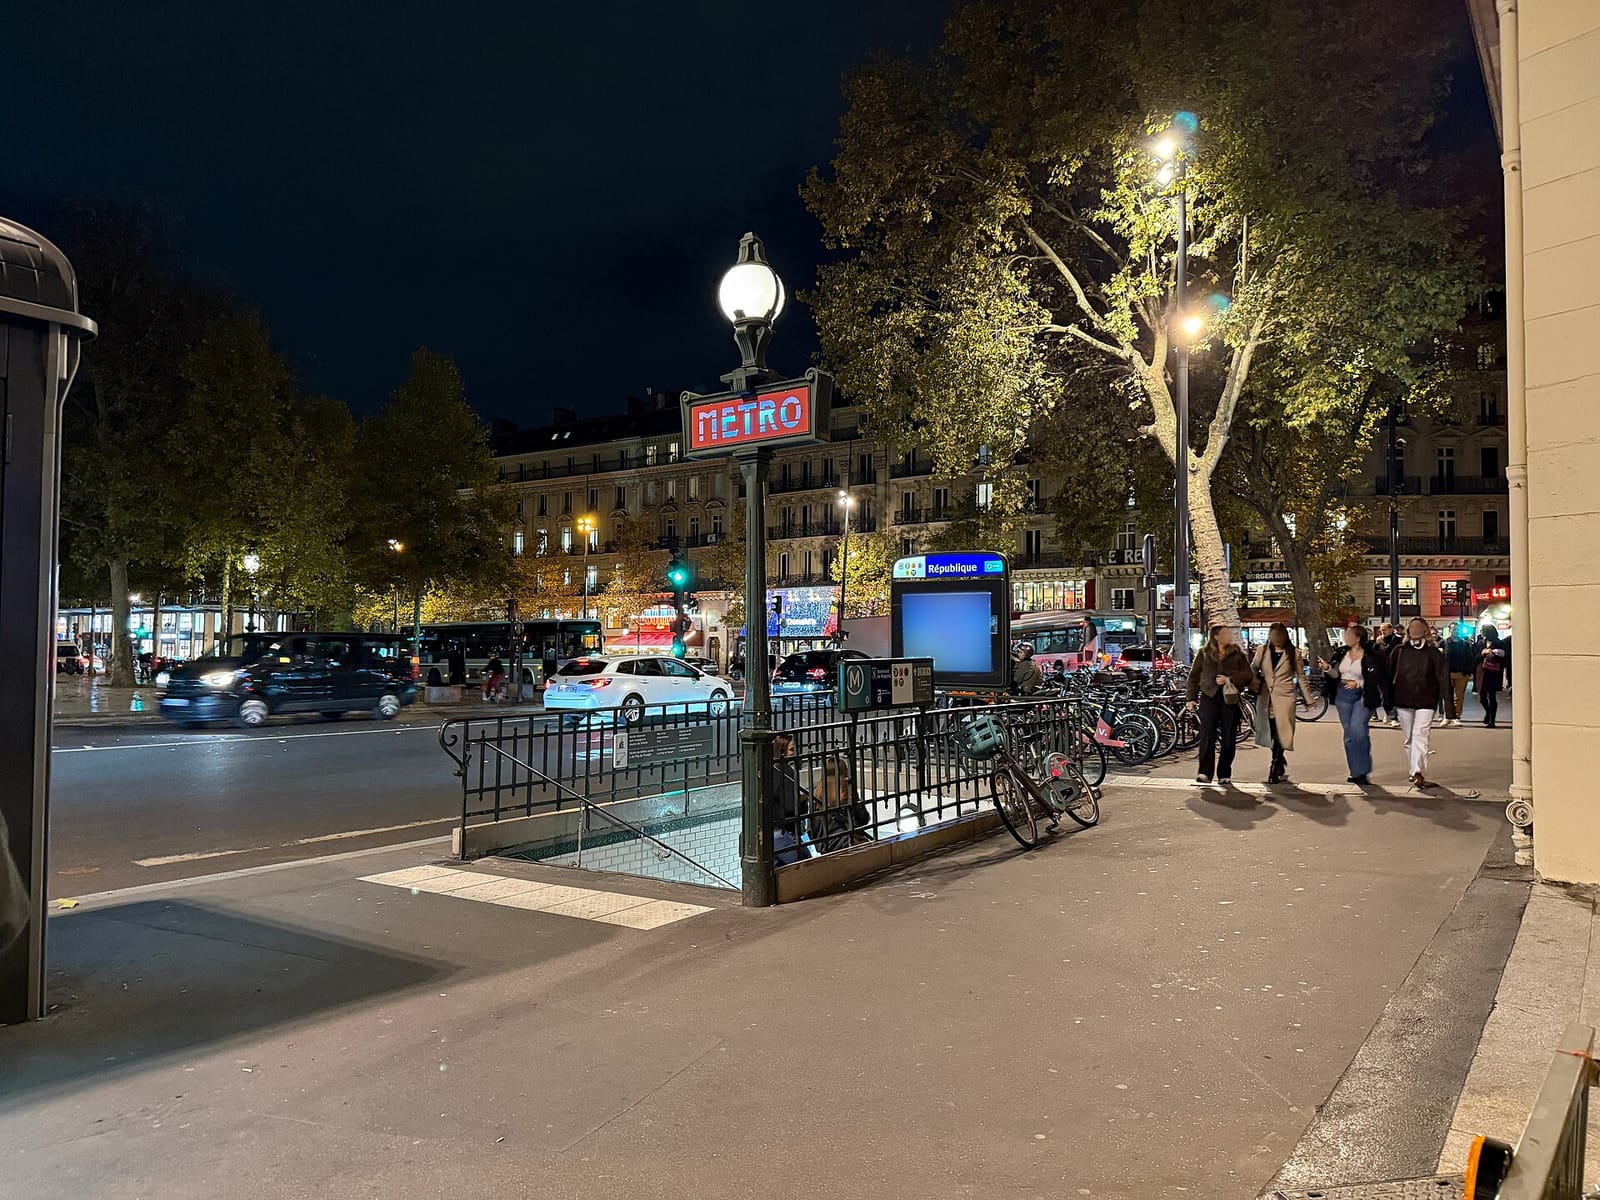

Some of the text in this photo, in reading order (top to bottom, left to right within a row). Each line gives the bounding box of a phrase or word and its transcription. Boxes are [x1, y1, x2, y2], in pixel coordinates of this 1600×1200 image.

[698, 396, 802, 442] METRO
[1124, 549, 1143, 564] RE
[928, 563, 978, 575] République
[849, 670, 860, 689] M
